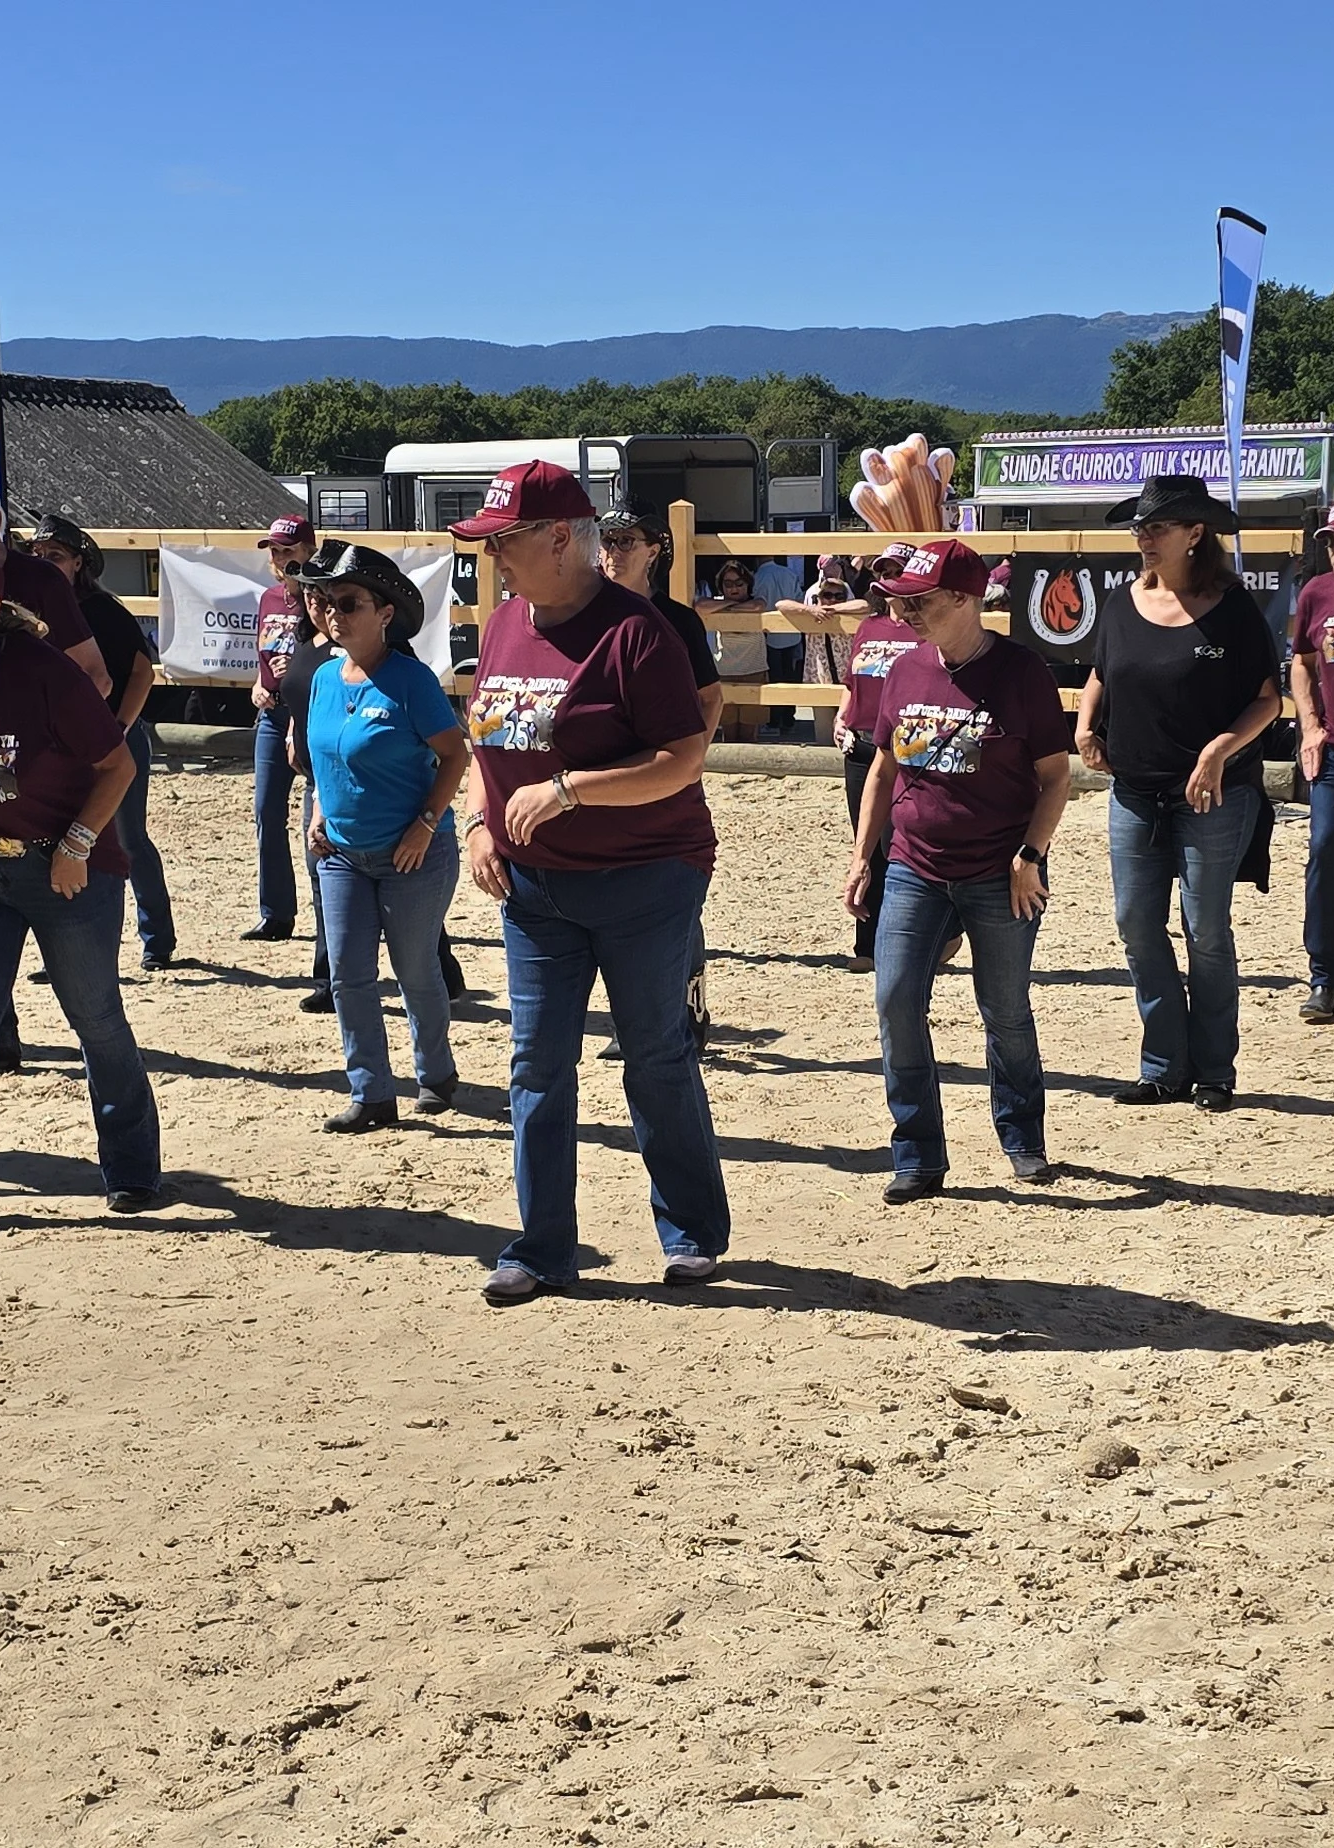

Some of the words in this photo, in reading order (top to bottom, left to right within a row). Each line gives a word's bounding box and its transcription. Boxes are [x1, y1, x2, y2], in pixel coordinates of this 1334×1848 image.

[999, 453, 1060, 483] SUNDAE
[1061, 451, 1134, 482] CHURROS
[1138, 450, 1178, 480] MILK
[1180, 449, 1231, 479] SHAKE
[1238, 447, 1305, 477] GRANITA
[458, 558, 473, 578] Le
[203, 637, 217, 648] La
[225, 638, 258, 650] géra
[503, 720, 529, 751] 25
